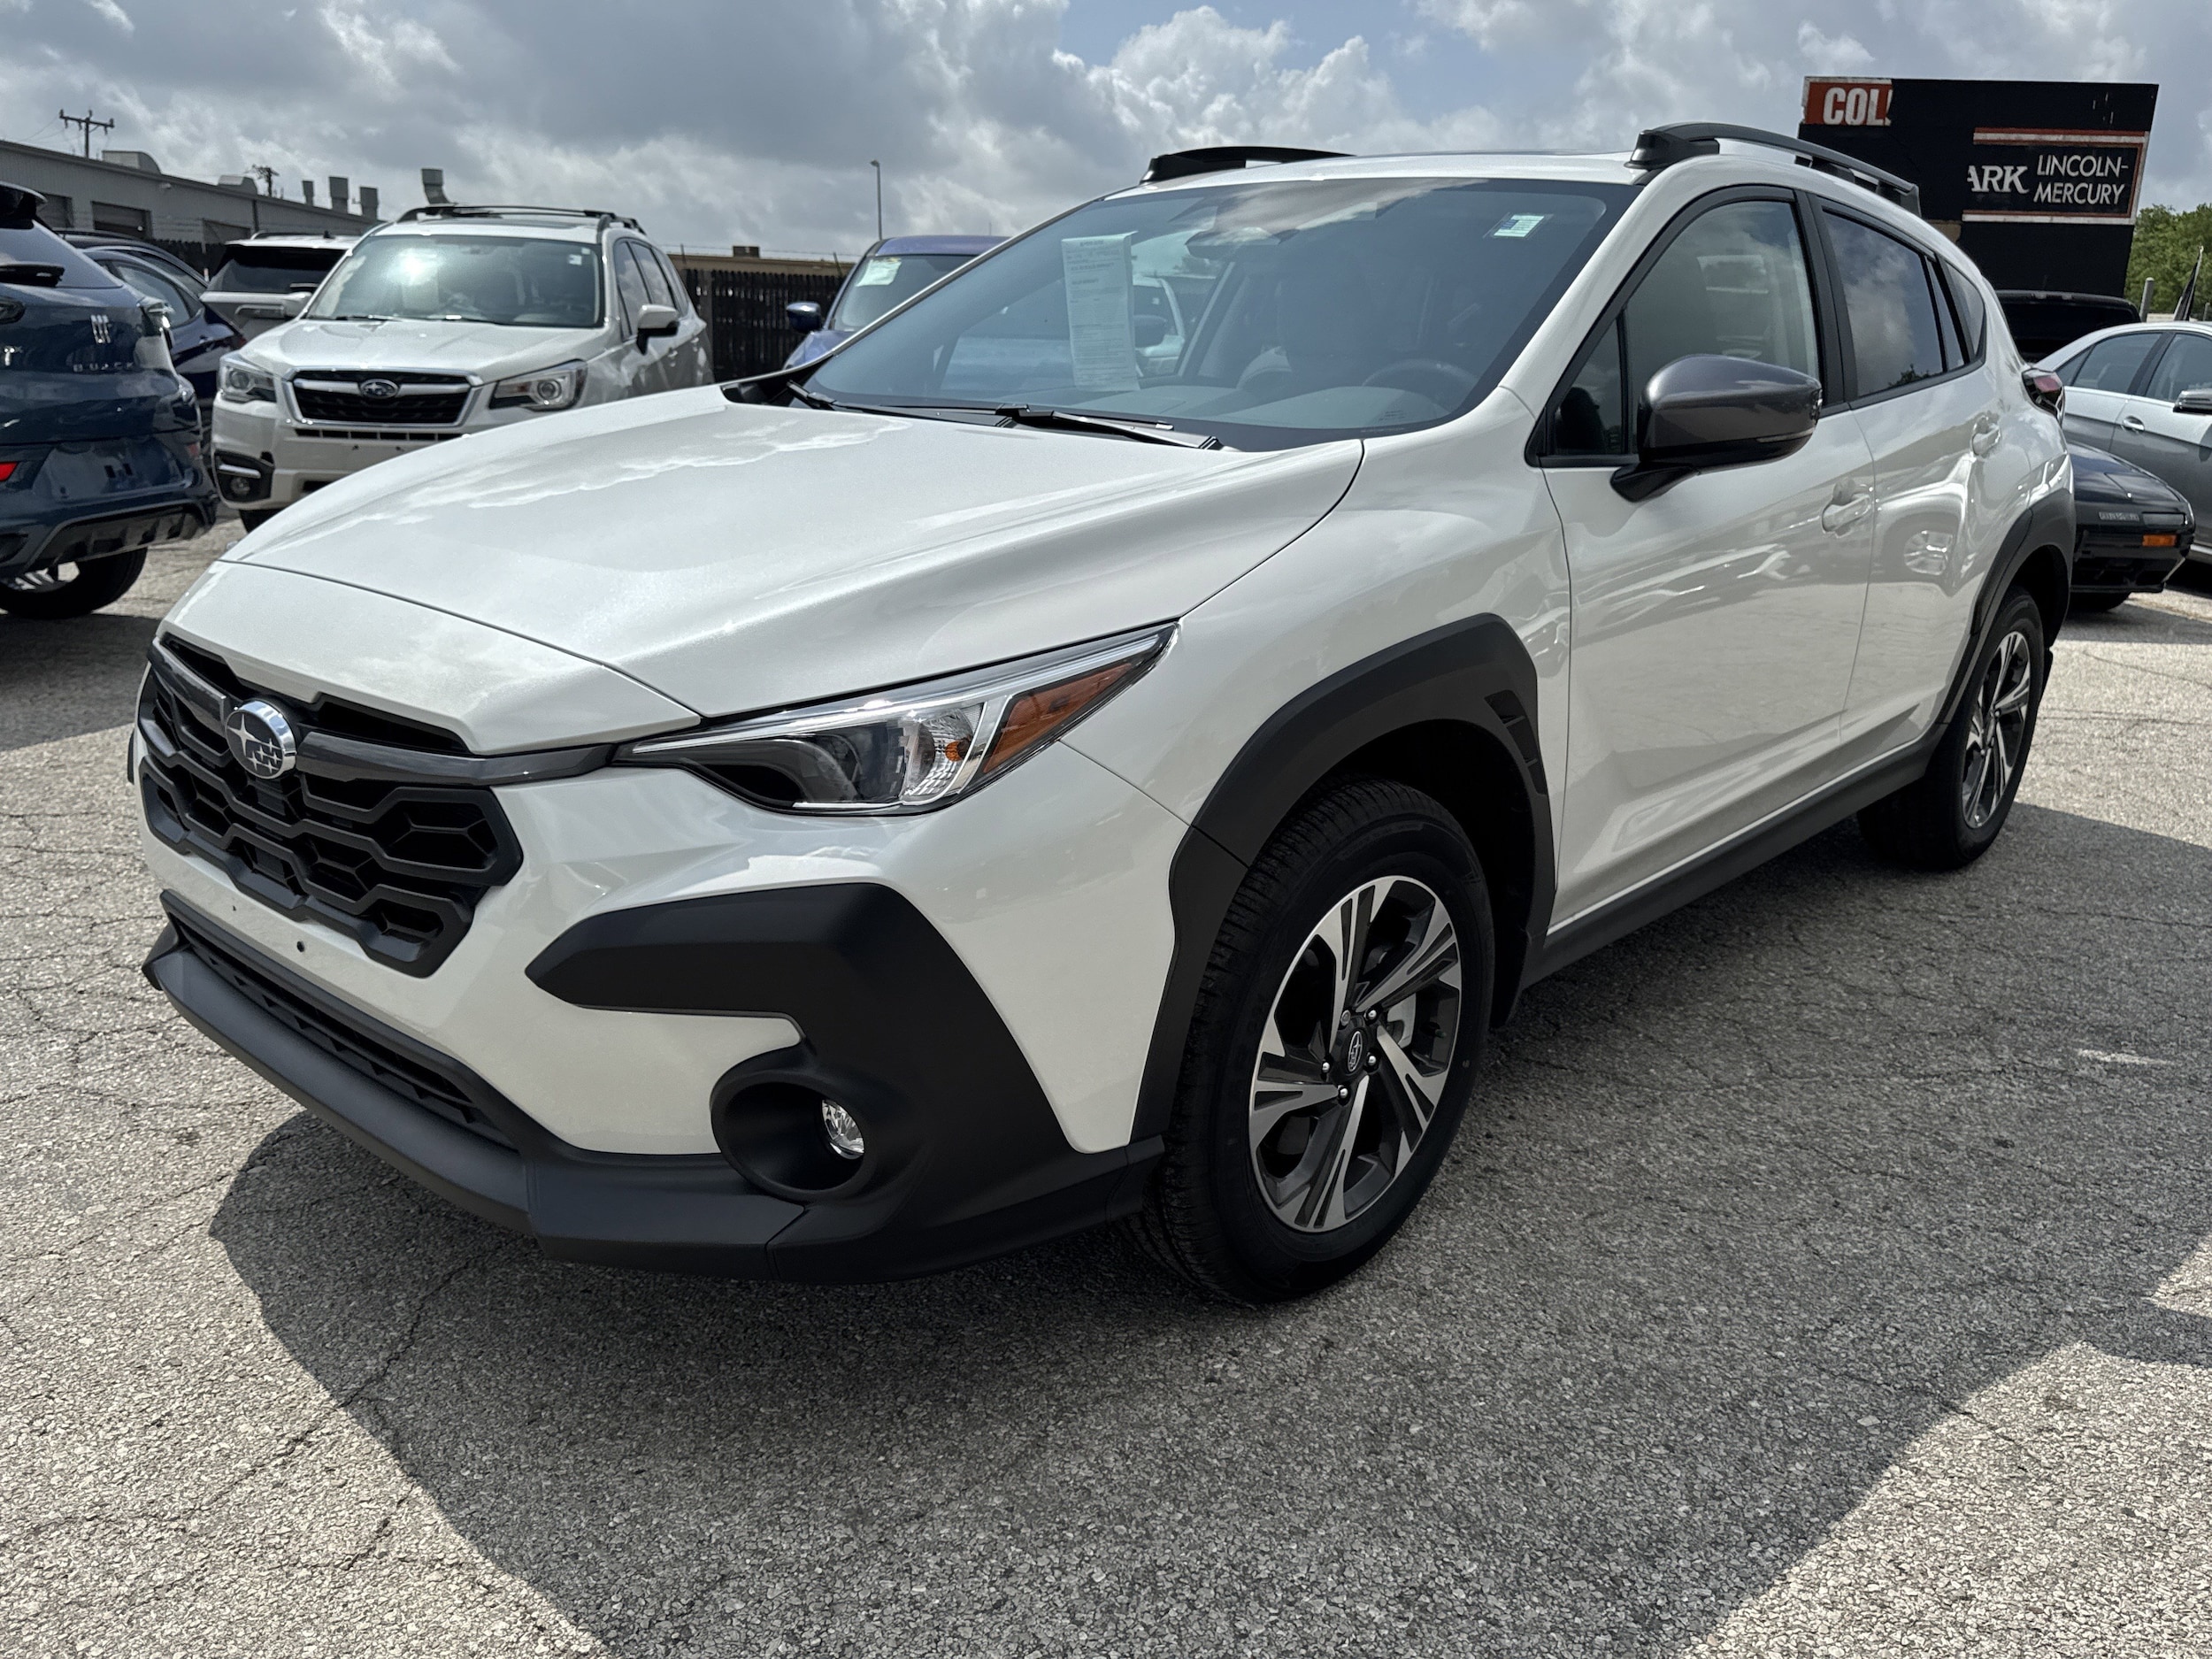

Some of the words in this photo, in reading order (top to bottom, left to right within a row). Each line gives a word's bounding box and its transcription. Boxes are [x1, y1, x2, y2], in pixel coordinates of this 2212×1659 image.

[1823, 87, 1893, 127] COL
[2037, 154, 2129, 178] LINCOLN-
[2033, 181, 2125, 204] MERCURY
